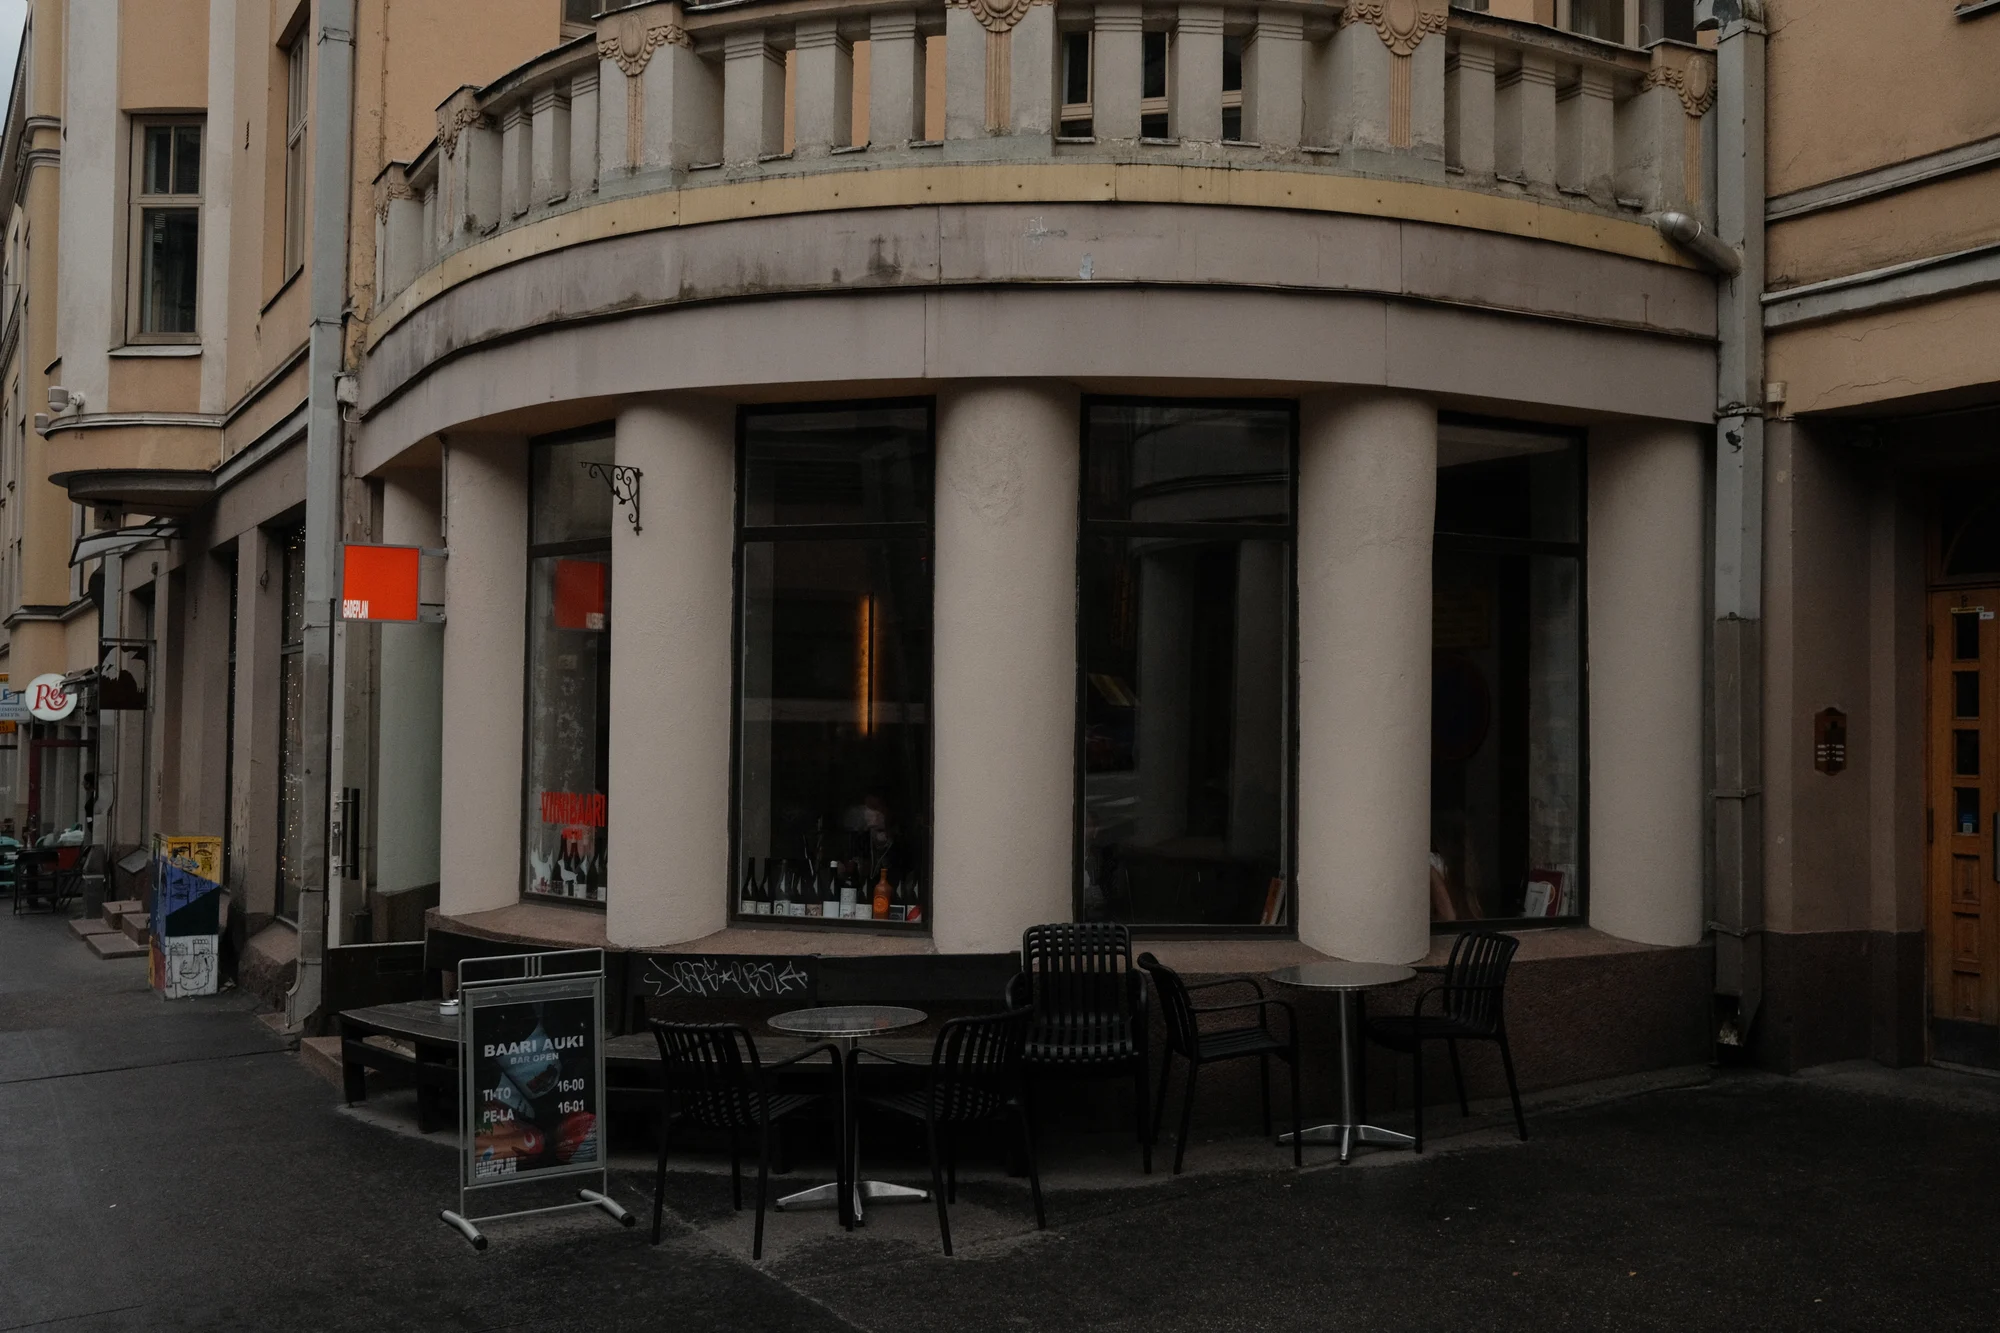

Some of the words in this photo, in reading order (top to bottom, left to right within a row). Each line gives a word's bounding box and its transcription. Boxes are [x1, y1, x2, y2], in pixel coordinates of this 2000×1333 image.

[541, 791, 607, 828] VIINIBAARI
[484, 1039, 536, 1058] BAARI
[542, 1035, 584, 1051] AUKI
[511, 1056, 530, 1065] BAR
[533, 1052, 559, 1062] OPEN
[483, 1087, 511, 1102] TI-TO
[557, 1078, 585, 1092] 16-00
[483, 1109, 515, 1123] PE-LA
[558, 1099, 585, 1114] 16-01
